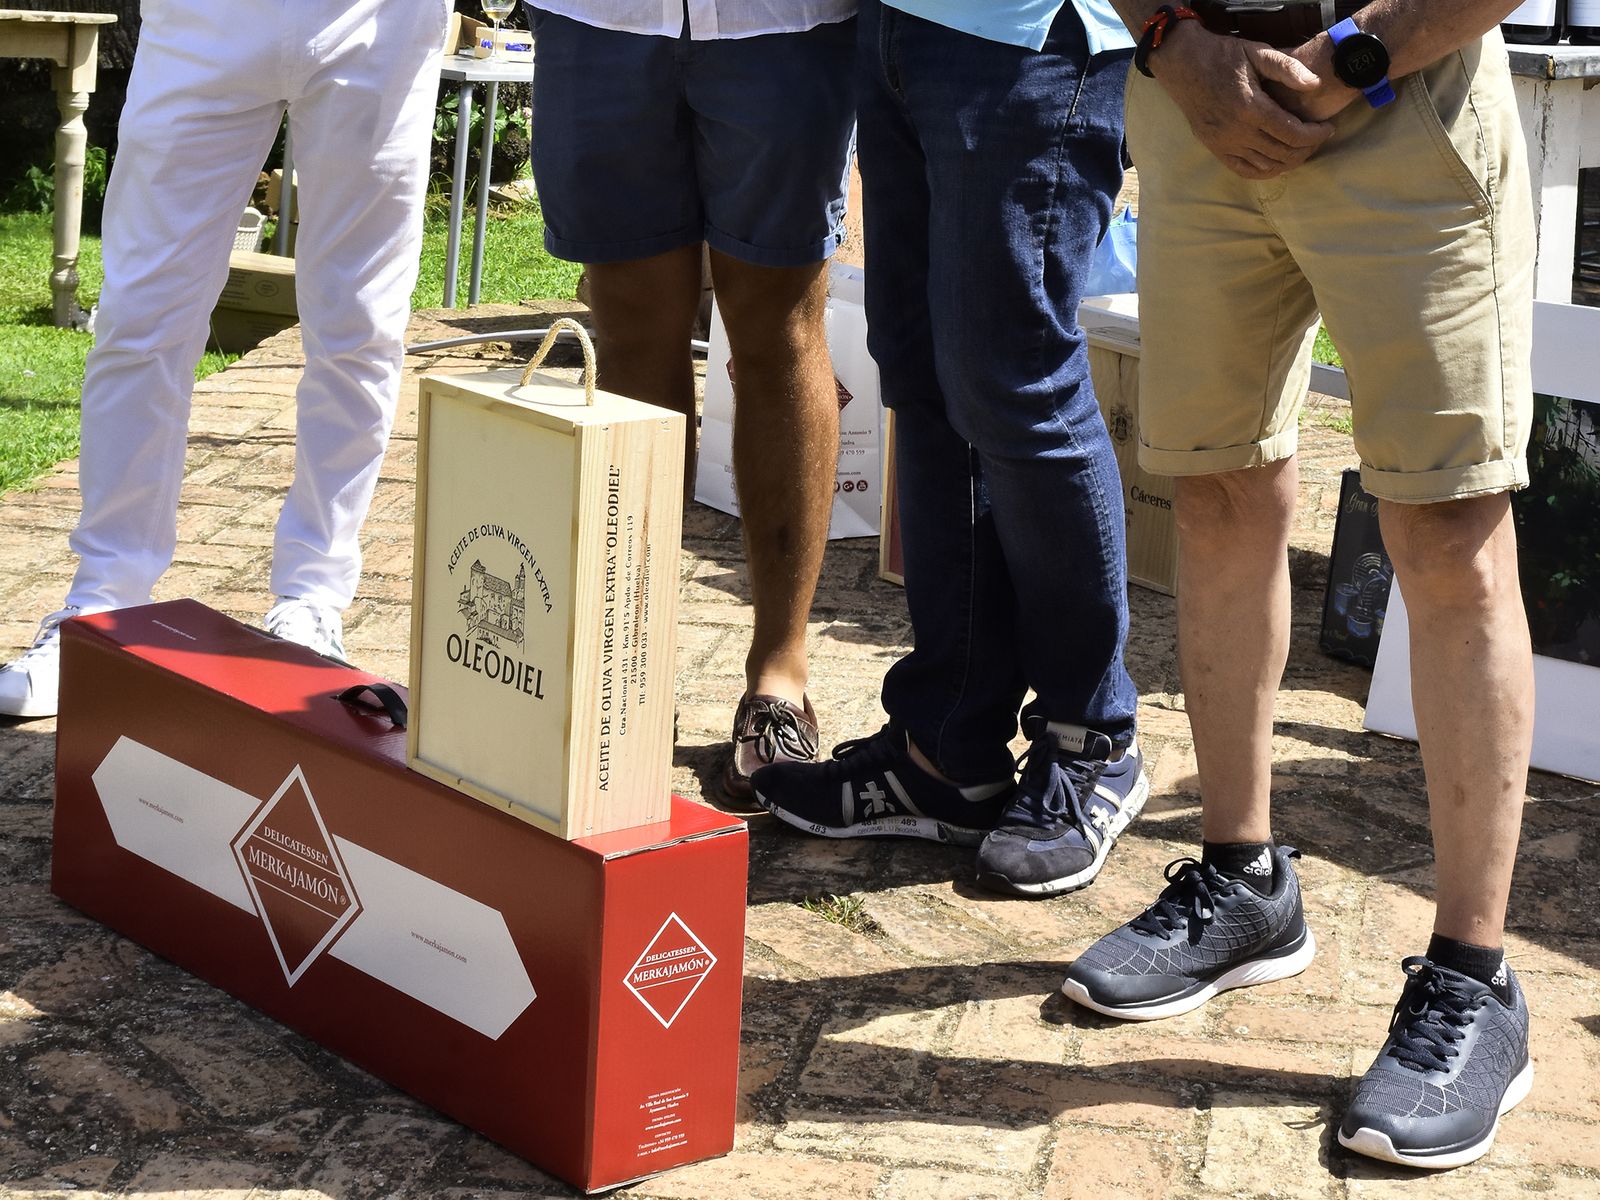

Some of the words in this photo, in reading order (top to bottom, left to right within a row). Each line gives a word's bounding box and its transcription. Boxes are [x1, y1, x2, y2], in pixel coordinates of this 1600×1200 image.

[1347, 51, 1376, 74] 16:21
[1130, 485, 1172, 510] Cáceres
[447, 536, 469, 575] ACEITE
[468, 527, 479, 542] DE
[480, 524, 505, 540] OLIVA
[507, 530, 536, 569] VIRGEN
[534, 567, 553, 614] EXTRA
[603, 607, 615, 664] VIRGEN
[640, 632, 648, 649] 033
[446, 633, 545, 700] OLEODIEL
[621, 658, 629, 674] 431
[639, 651, 647, 669] 300
[601, 668, 613, 711] OLIVA
[601, 715, 611, 736] DE
[599, 739, 610, 791] ACEITE
[809, 824, 827, 834] 483
[900, 818, 917, 827] 483
[264, 825, 328, 866] DELICATESSEN
[248, 845, 339, 905] MERKAJAMÓN
[1242, 865, 1273, 877] adid
[645, 945, 697, 963] DELICATESSEN
[633, 958, 705, 984] MERKAJAMÓN
